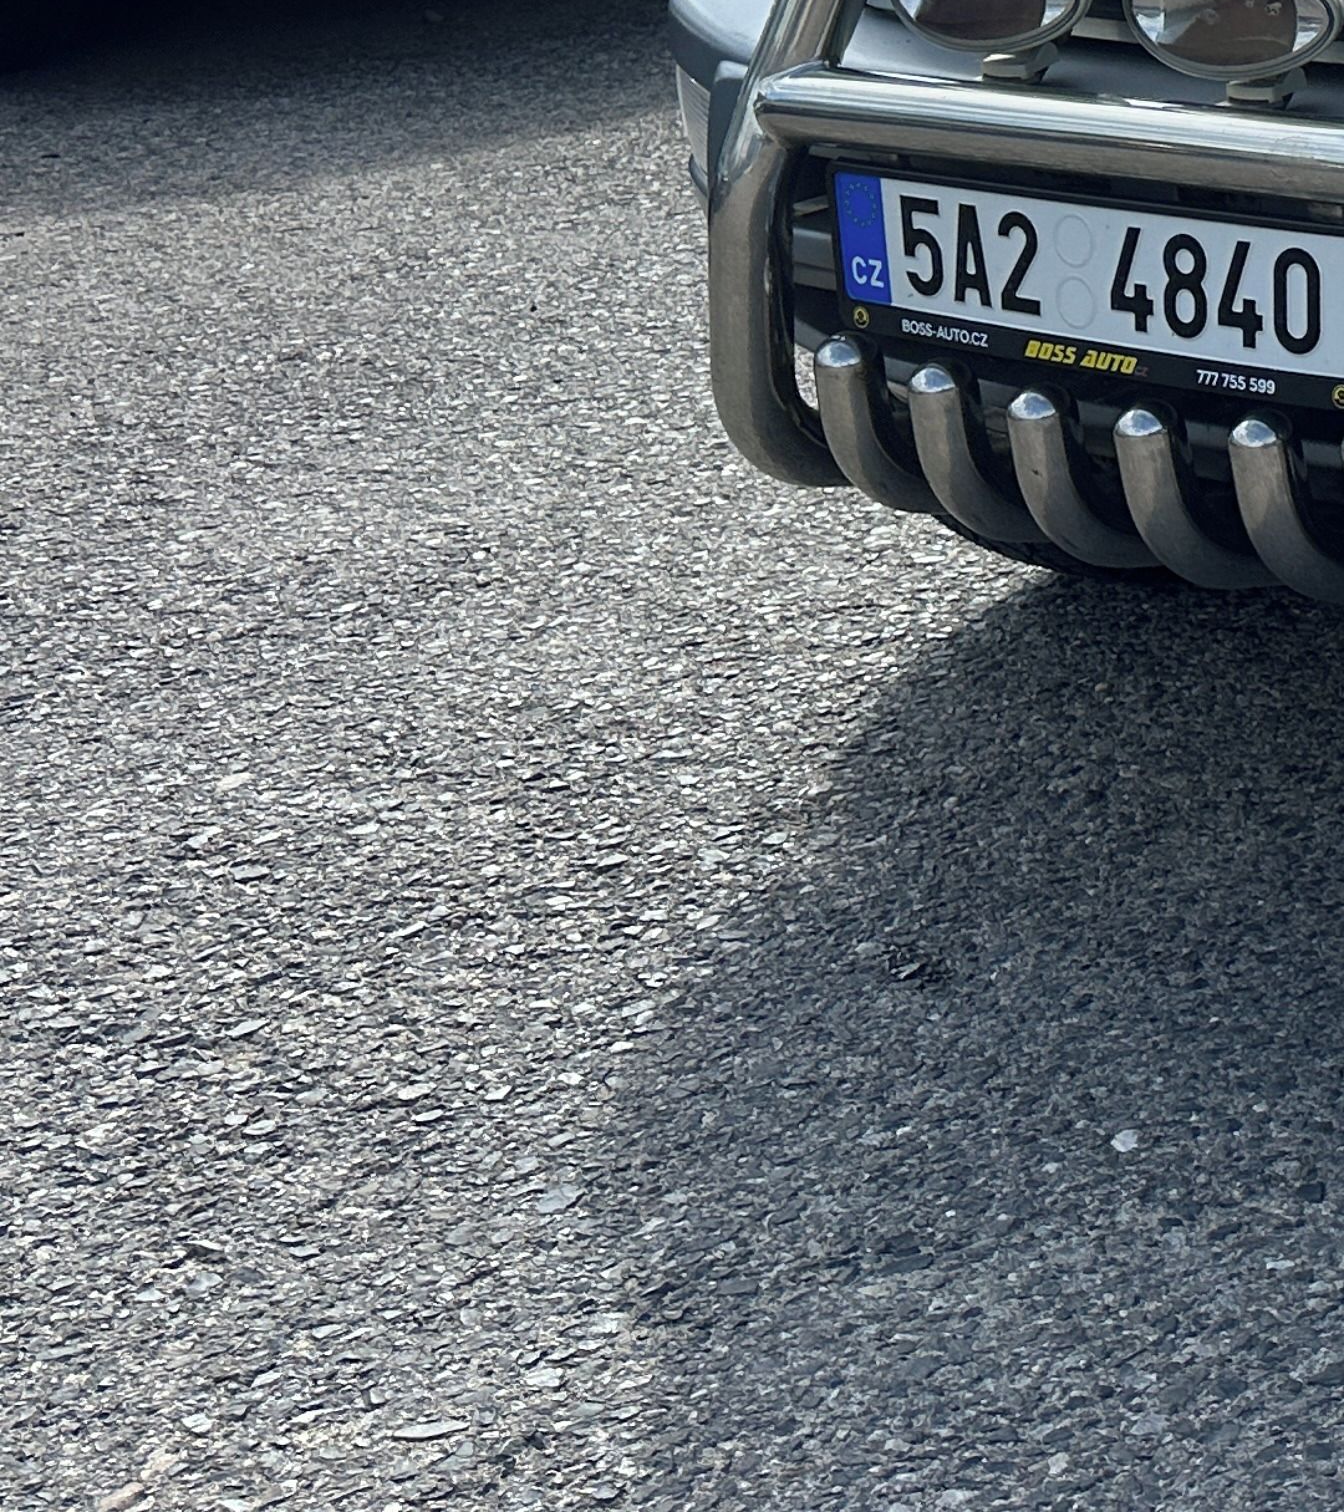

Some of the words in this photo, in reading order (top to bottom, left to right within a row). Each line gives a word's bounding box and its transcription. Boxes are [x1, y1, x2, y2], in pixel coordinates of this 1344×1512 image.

[850, 254, 885, 289] CZ
[898, 193, 1043, 318] 5A2
[1109, 226, 1323, 356] 4840
[901, 317, 989, 348] BOSS-AUTO.CZ
[1023, 338, 1077, 366] BOSS
[1079, 347, 1138, 376] AUTO
[1196, 368, 1219, 387] 777
[1221, 371, 1247, 391] 755
[1248, 376, 1276, 396] 599
